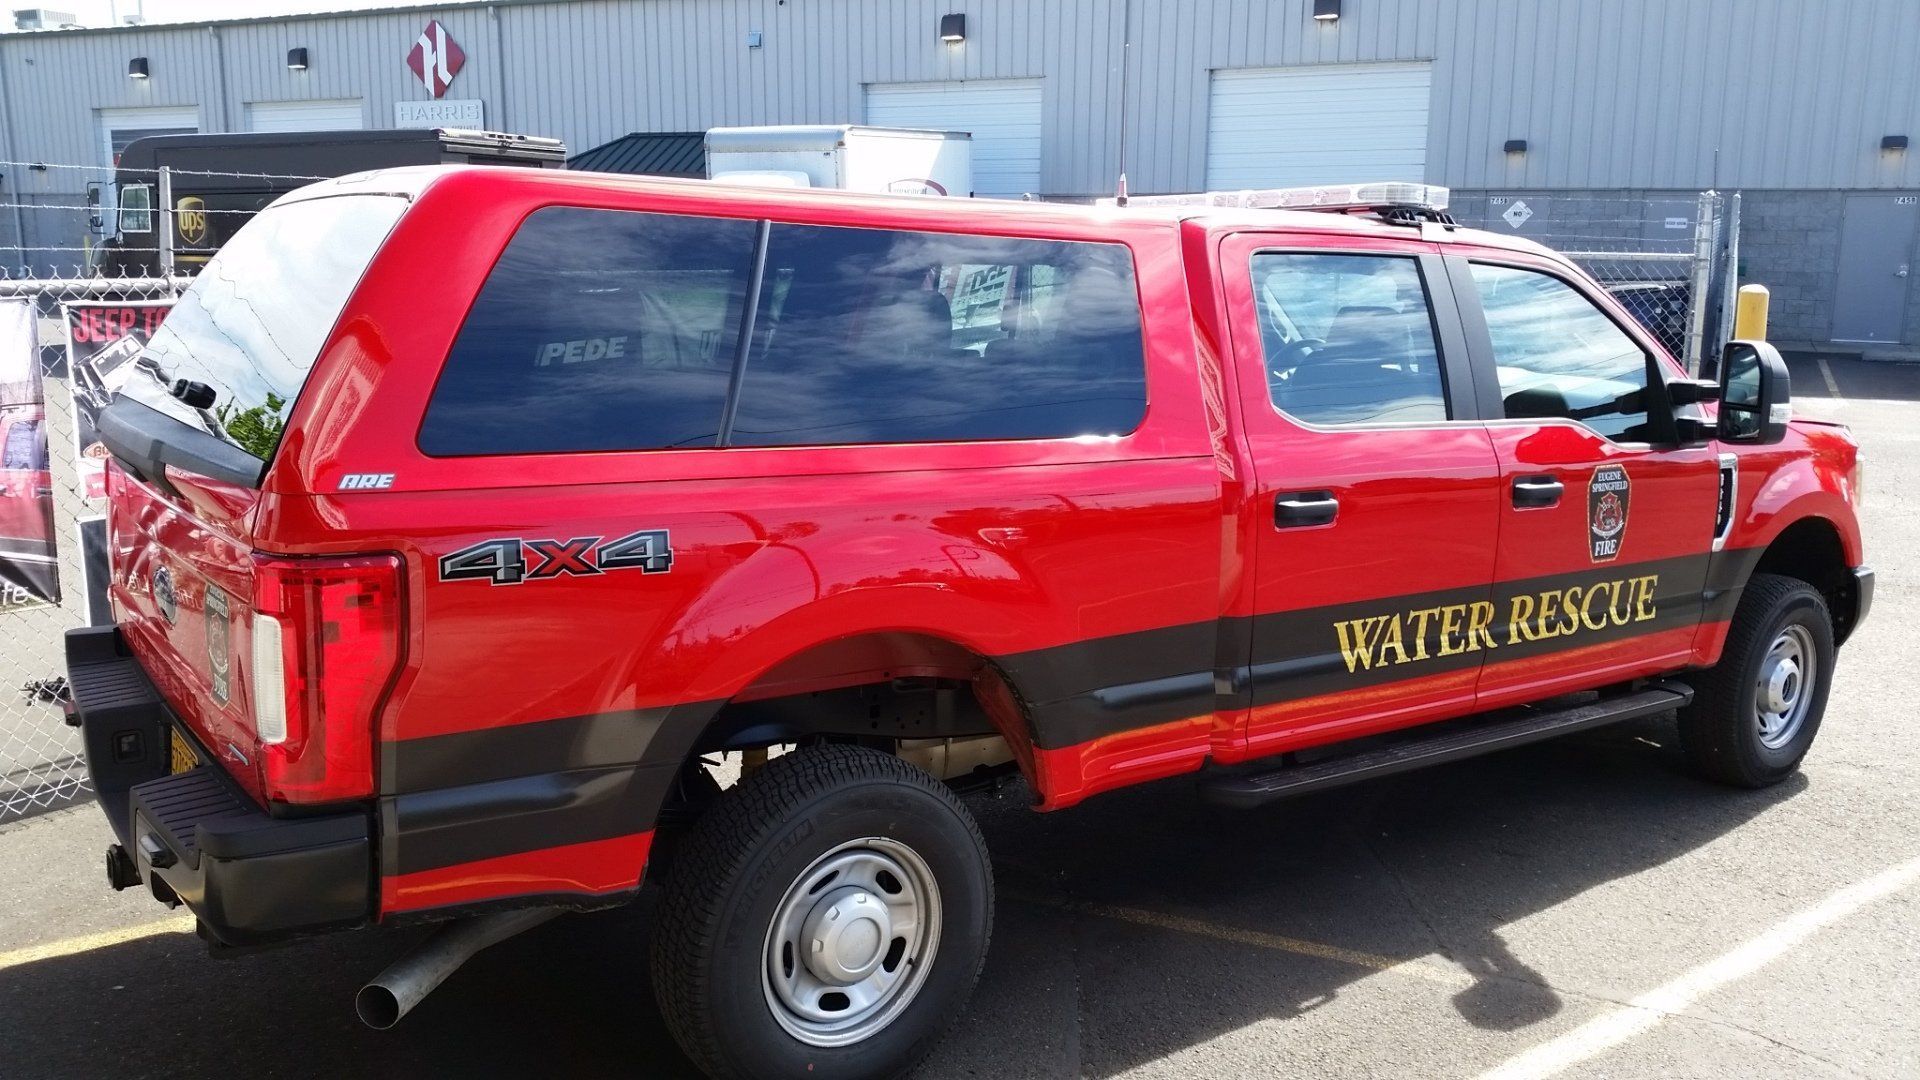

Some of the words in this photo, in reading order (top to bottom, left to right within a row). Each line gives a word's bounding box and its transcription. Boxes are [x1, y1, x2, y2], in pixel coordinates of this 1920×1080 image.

[400, 104, 480, 121] HARRIS
[180, 211, 204, 237] ups
[73, 306, 136, 343] JEEP
[533, 335, 628, 367] PEDE
[338, 473, 395, 490] ARE
[1592, 480, 1628, 493] SPRINGFIELD
[1598, 470, 1622, 482] EUGENE
[1594, 539, 1617, 557] FIRE
[0, 580, 29, 606] fe
[1333, 600, 1498, 674] WATER
[1507, 574, 1659, 645] RESCUE
